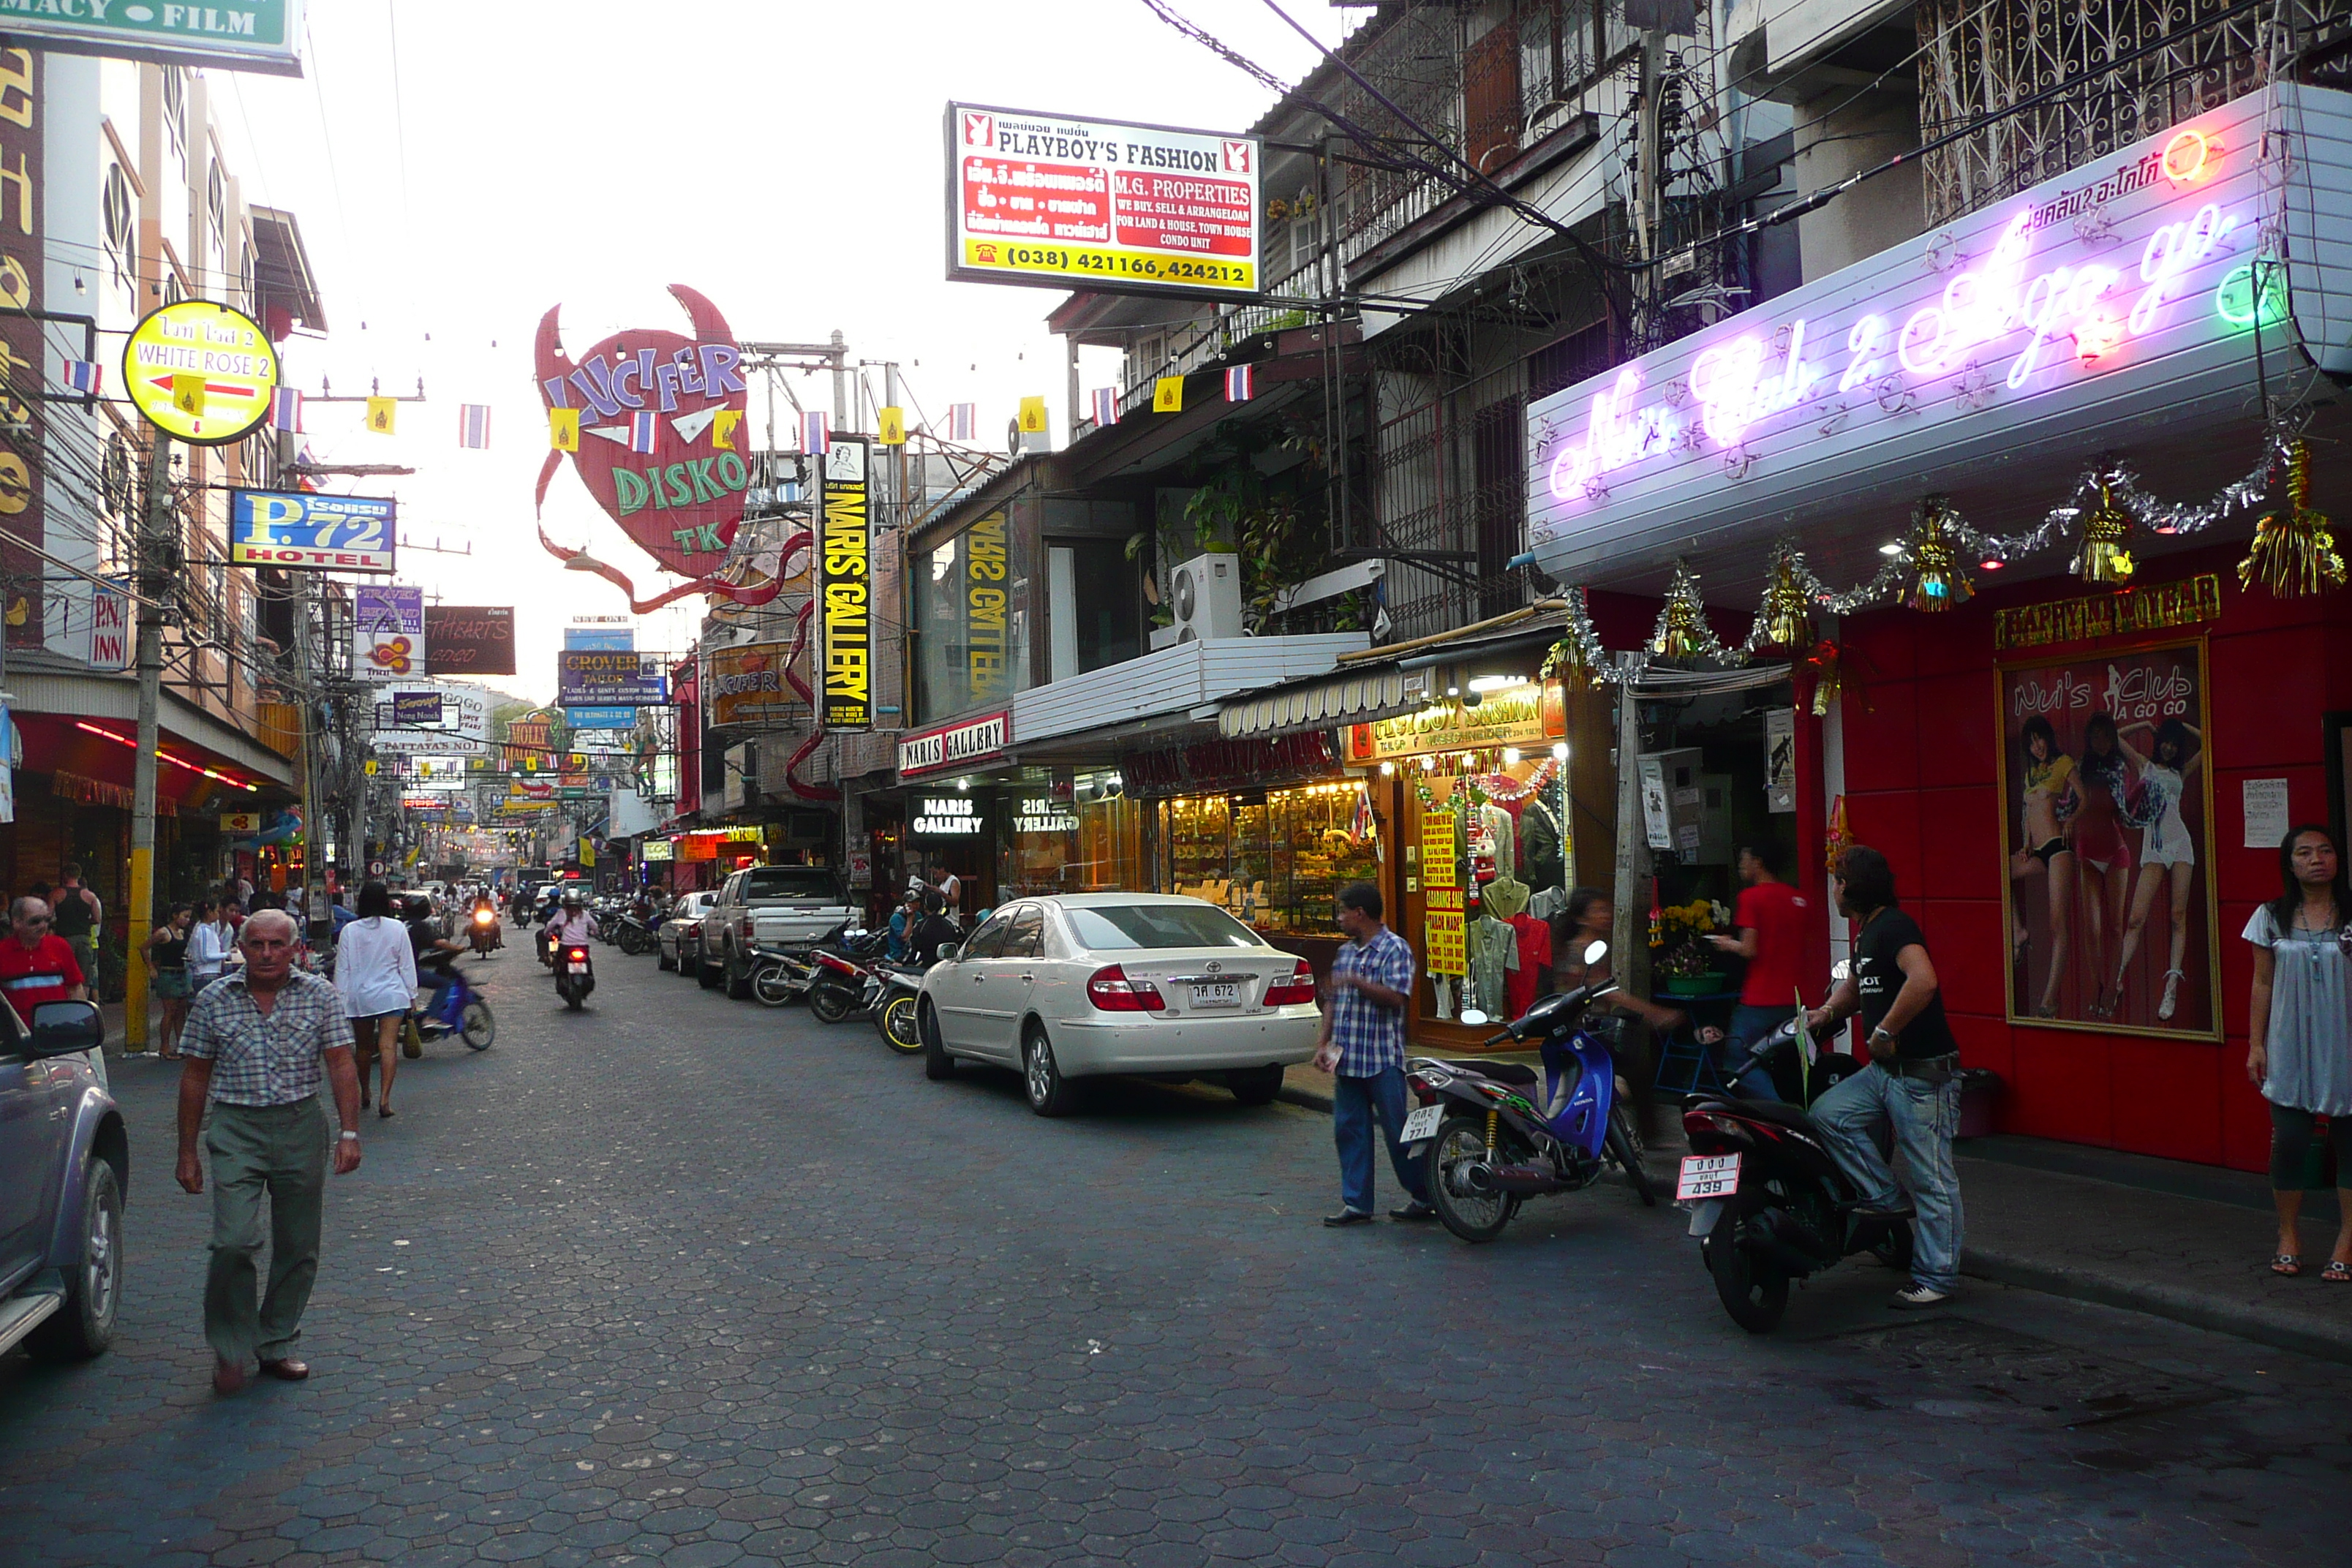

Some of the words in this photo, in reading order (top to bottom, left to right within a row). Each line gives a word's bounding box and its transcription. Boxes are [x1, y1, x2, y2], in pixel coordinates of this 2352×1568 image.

[162, 4, 255, 35] FILM
[998, 132, 1117, 162] PLAYBOY'S
[1127, 144, 1218, 173] FASHION
[1115, 176, 1148, 196] M.G.
[1153, 179, 1250, 206] PROPERTIES
[1117, 199, 1131, 211] WE
[1156, 202, 1177, 214] SELL
[1178, 205, 1185, 215] &
[1117, 215, 1134, 227] FOR
[1136, 216, 1158, 229] LAND
[1159, 219, 1166, 230] &
[1199, 222, 1223, 235] TOWN
[1224, 225, 1252, 238] HOUSE
[1161, 234, 1189, 246] CONDO
[1191, 237, 1210, 249] UNIT
[1008, 247, 1068, 269] (038)
[245, 332, 253, 346] 2
[138, 344, 197, 369] WHITE
[205, 352, 251, 374] ROSE
[258, 358, 268, 377] 2
[1838, 314, 1882, 393] 2
[543, 344, 747, 426] LUCIFER
[612, 452, 748, 516] DISKO
[244, 494, 384, 550] P.72
[673, 521, 726, 556] TK
[825, 493, 867, 576] NARIS
[246, 549, 382, 566] HOTEL
[364, 589, 417, 600] TRAVEL
[96, 595, 123, 628] P.N.
[94, 634, 122, 663] INN
[825, 582, 868, 702] GALLERY
[584, 674, 625, 684] TAILOR
[2015, 671, 2090, 716] Nui's
[2118, 665, 2193, 702] Club
[397, 712, 415, 720] Nong
[2134, 704, 2157, 719] GO
[2163, 700, 2186, 715] GO
[512, 725, 548, 744] MOLLY
[908, 739, 941, 764] NARIS
[946, 722, 1001, 758] GALLERY
[385, 742, 449, 750] PATTAYA'S
[924, 799, 973, 815] NARIS
[913, 817, 983, 834] GALLERY
[1427, 890, 1451, 908] CLEARANCE
[1452, 890, 1463, 908] SALE
[1215, 984, 1234, 996] 672
[1574, 1097, 1594, 1107] HONDA
[1409, 1127, 1427, 1139] 771
[1692, 1181, 1722, 1194] 439
